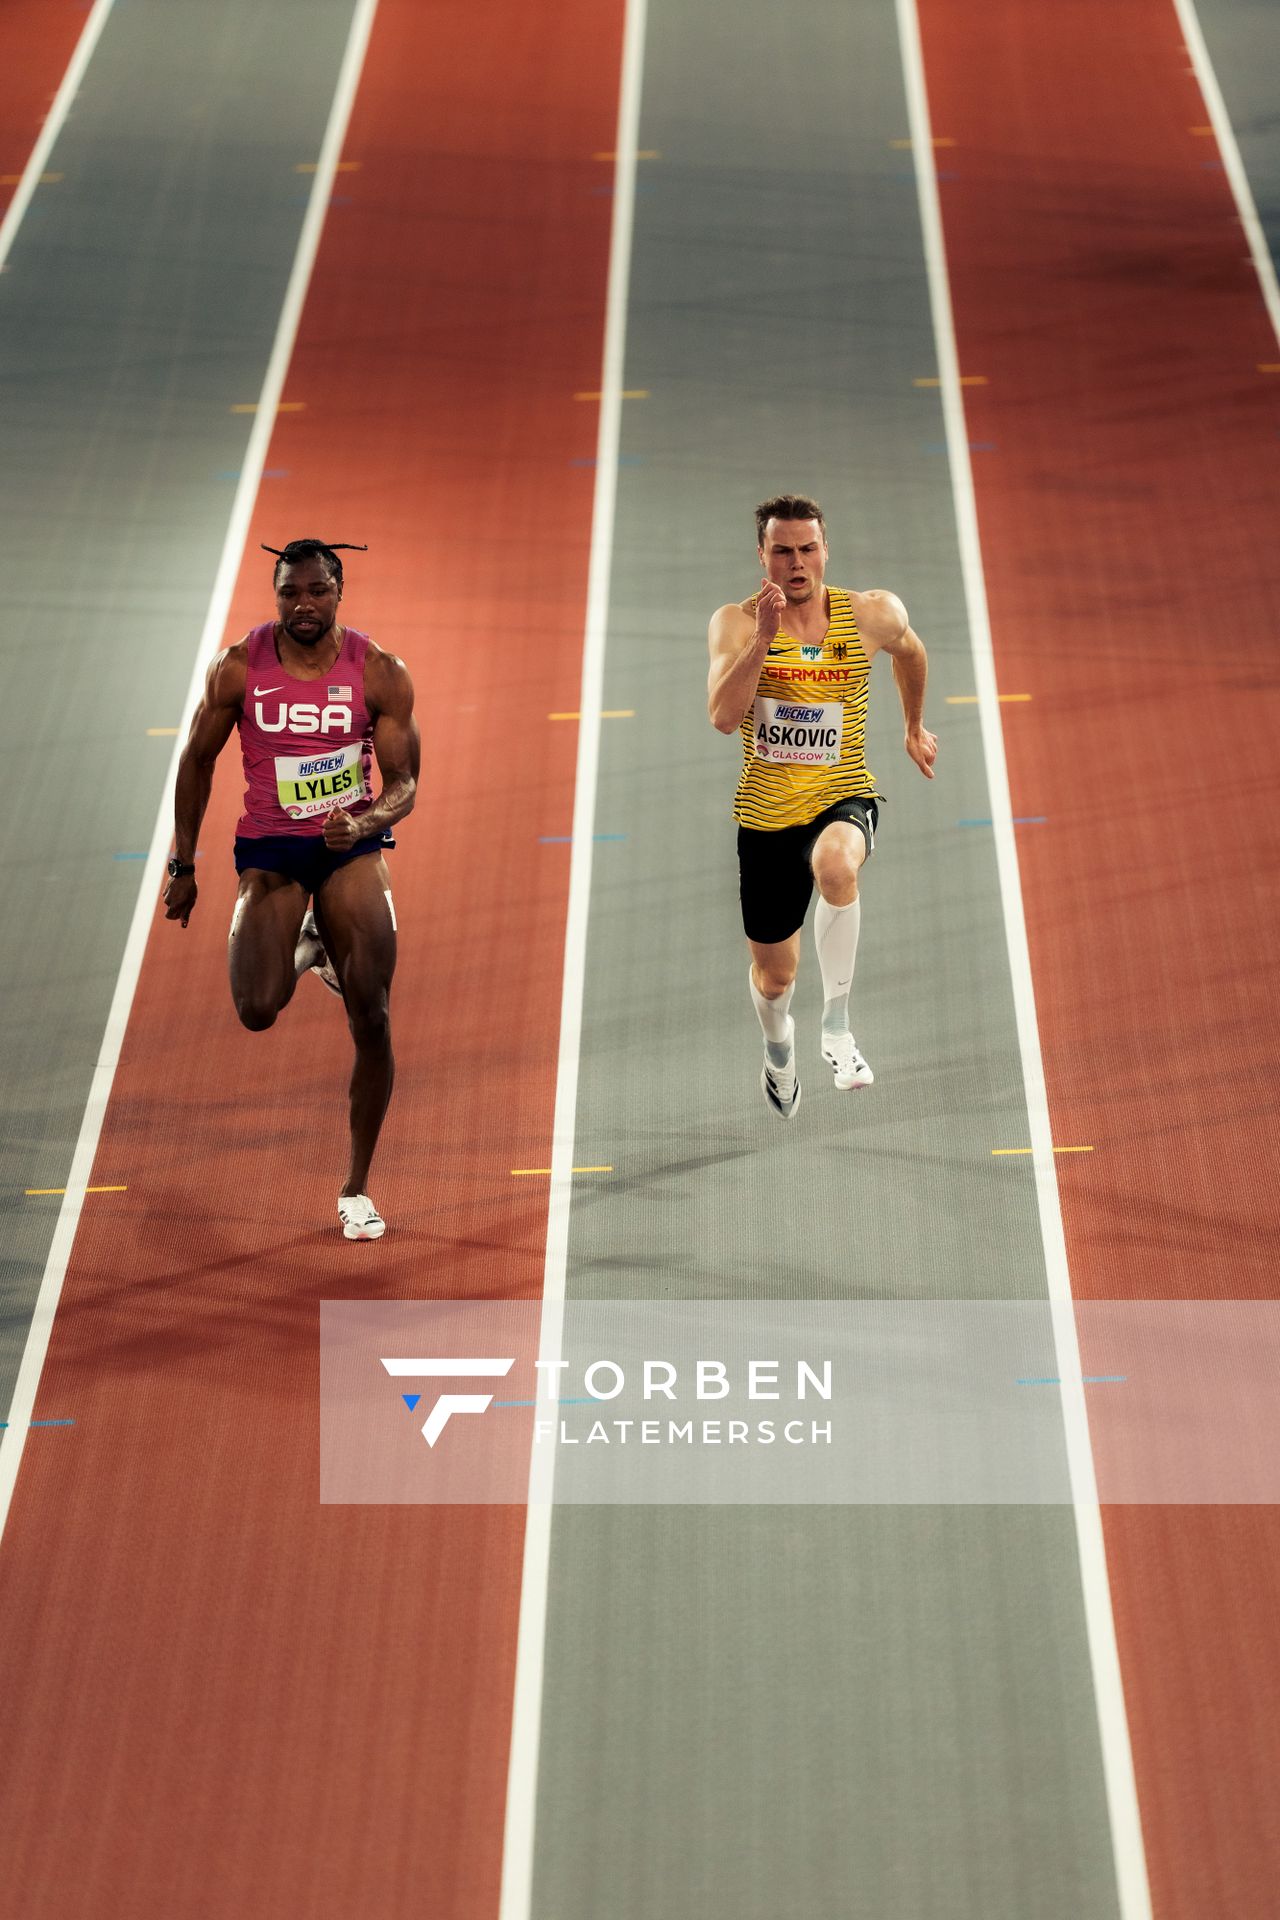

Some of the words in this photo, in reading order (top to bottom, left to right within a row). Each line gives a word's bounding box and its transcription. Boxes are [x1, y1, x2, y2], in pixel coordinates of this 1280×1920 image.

[766, 667, 851, 681] GERMANY
[254, 702, 352, 734] USA
[757, 723, 837, 748] ASKOVIC
[772, 750, 824, 760] GLASGOW
[825, 752, 836, 760] 24
[294, 769, 352, 801] LYLES
[305, 792, 353, 813] GLASGOW
